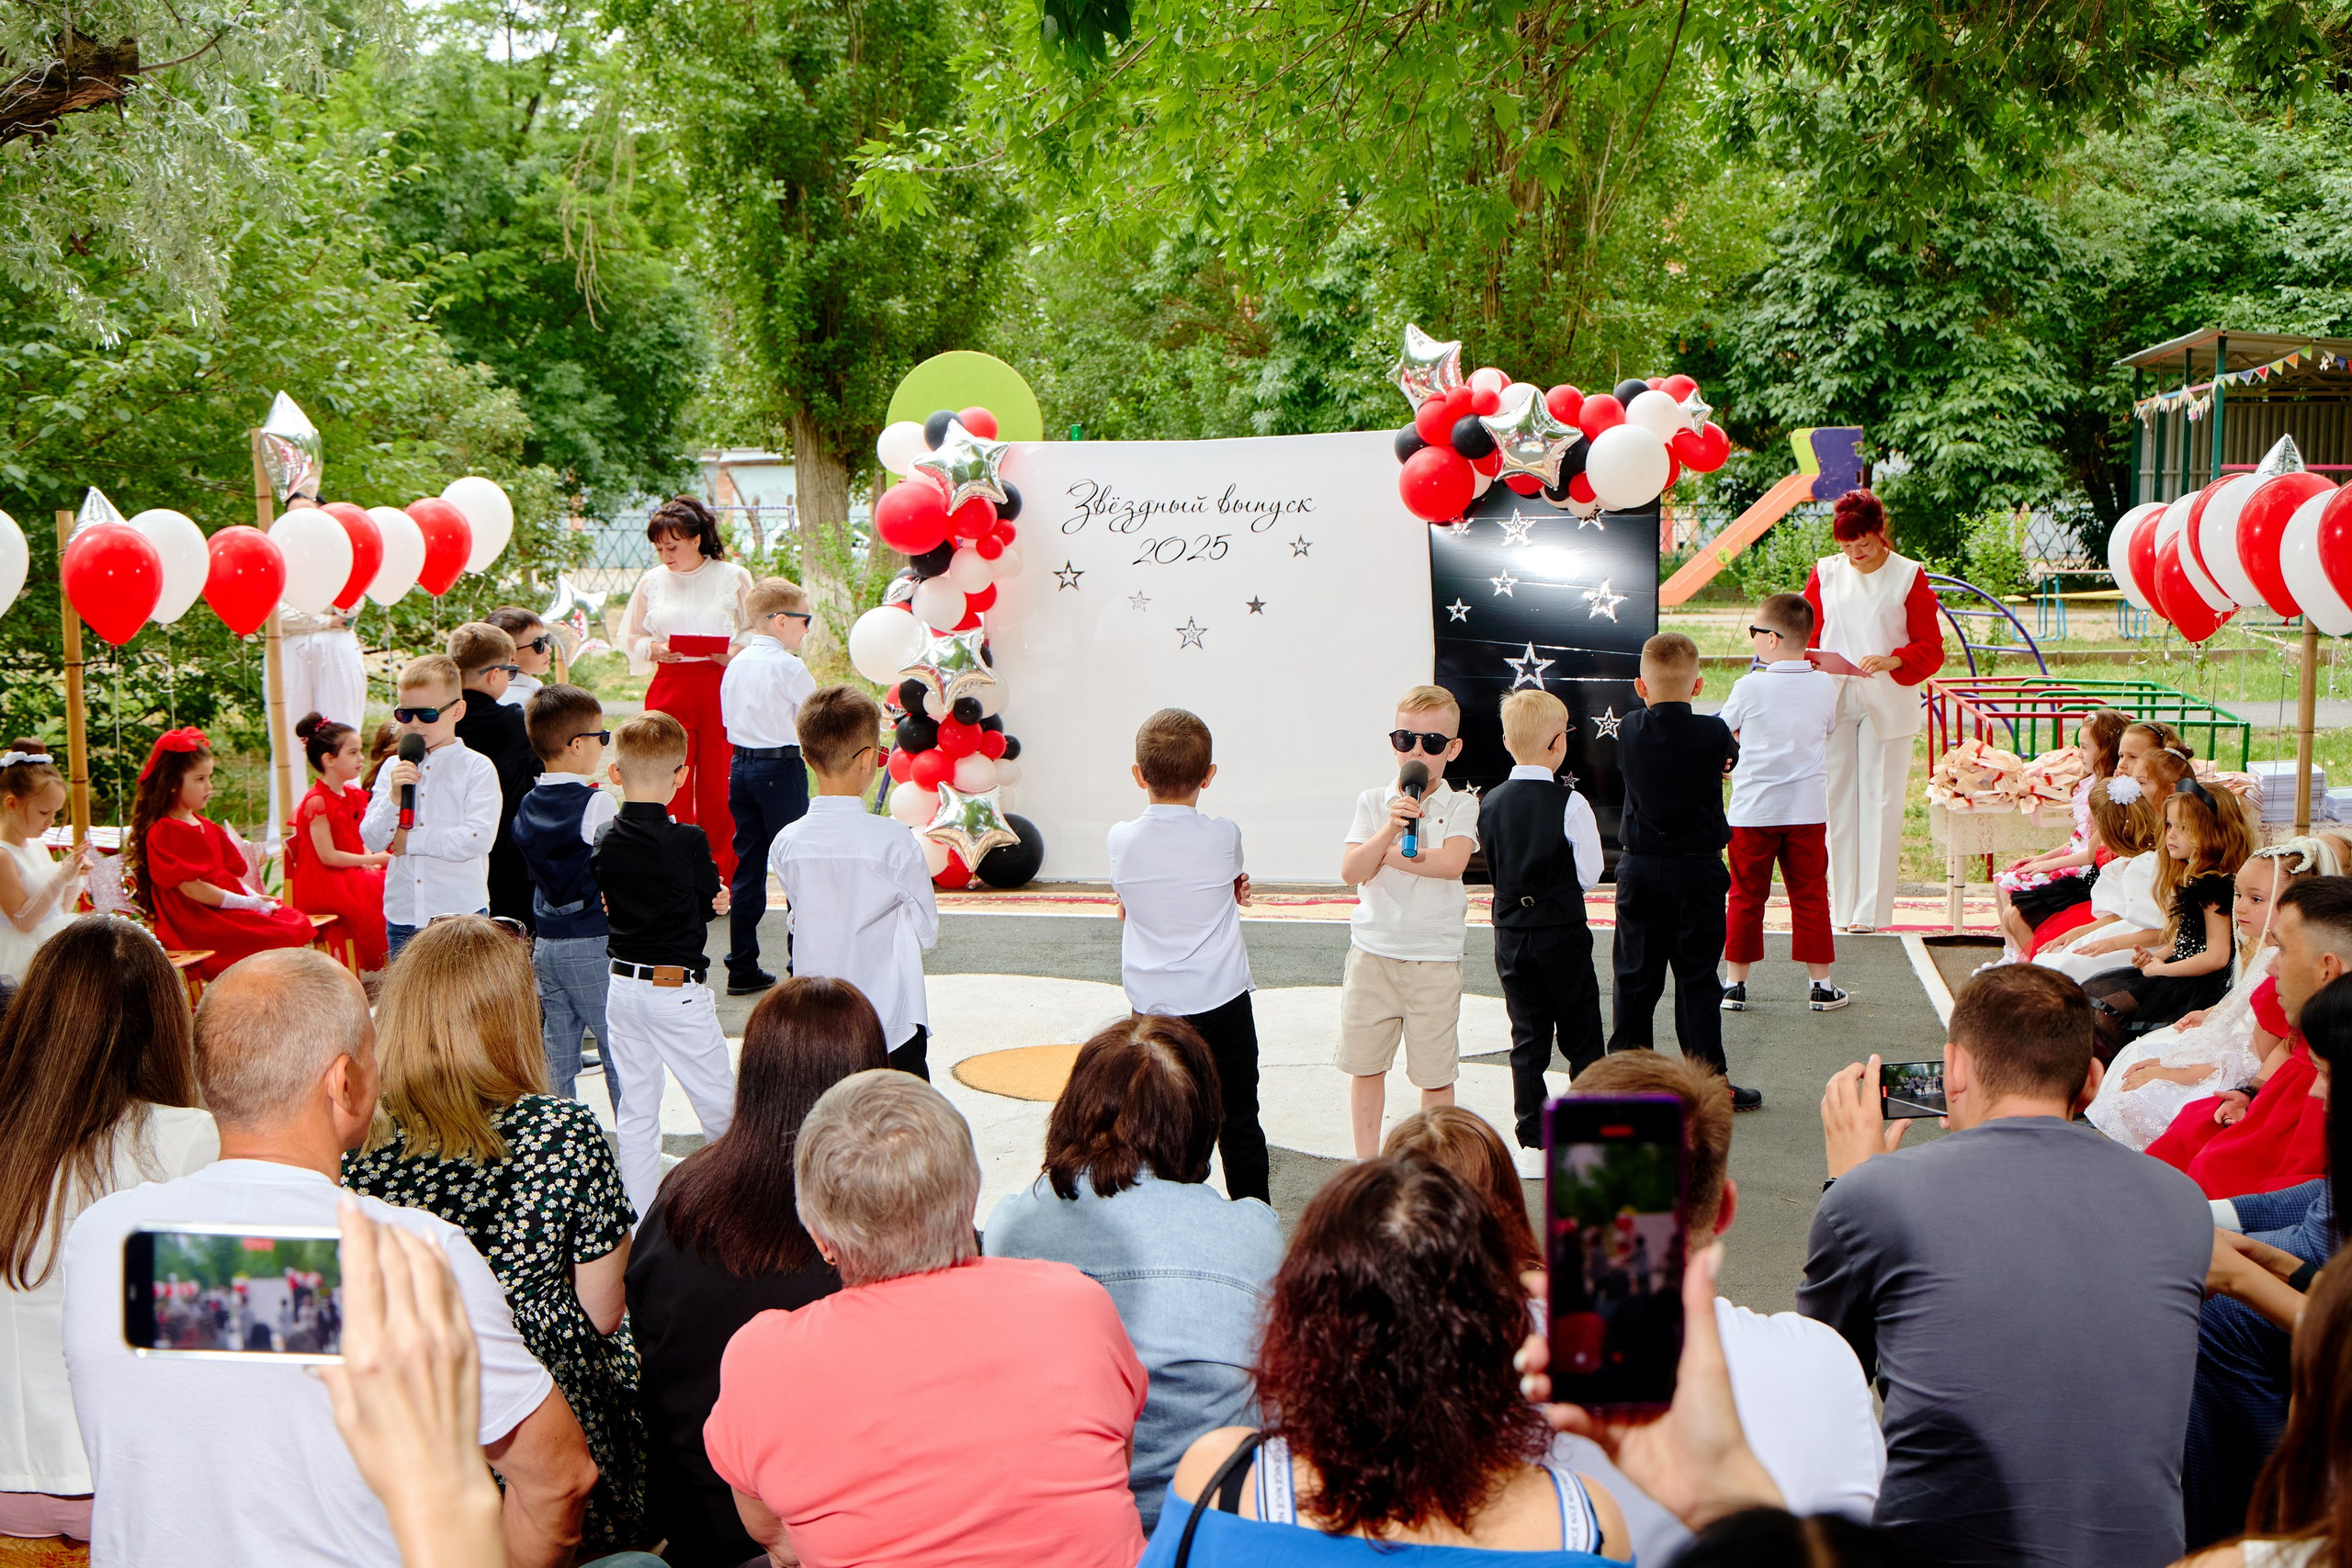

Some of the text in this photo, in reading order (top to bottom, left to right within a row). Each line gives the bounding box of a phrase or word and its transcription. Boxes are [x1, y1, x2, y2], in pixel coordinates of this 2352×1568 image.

[1061, 479, 1317, 535] Звёздный выпуск
[1132, 534, 1232, 566] 2025
